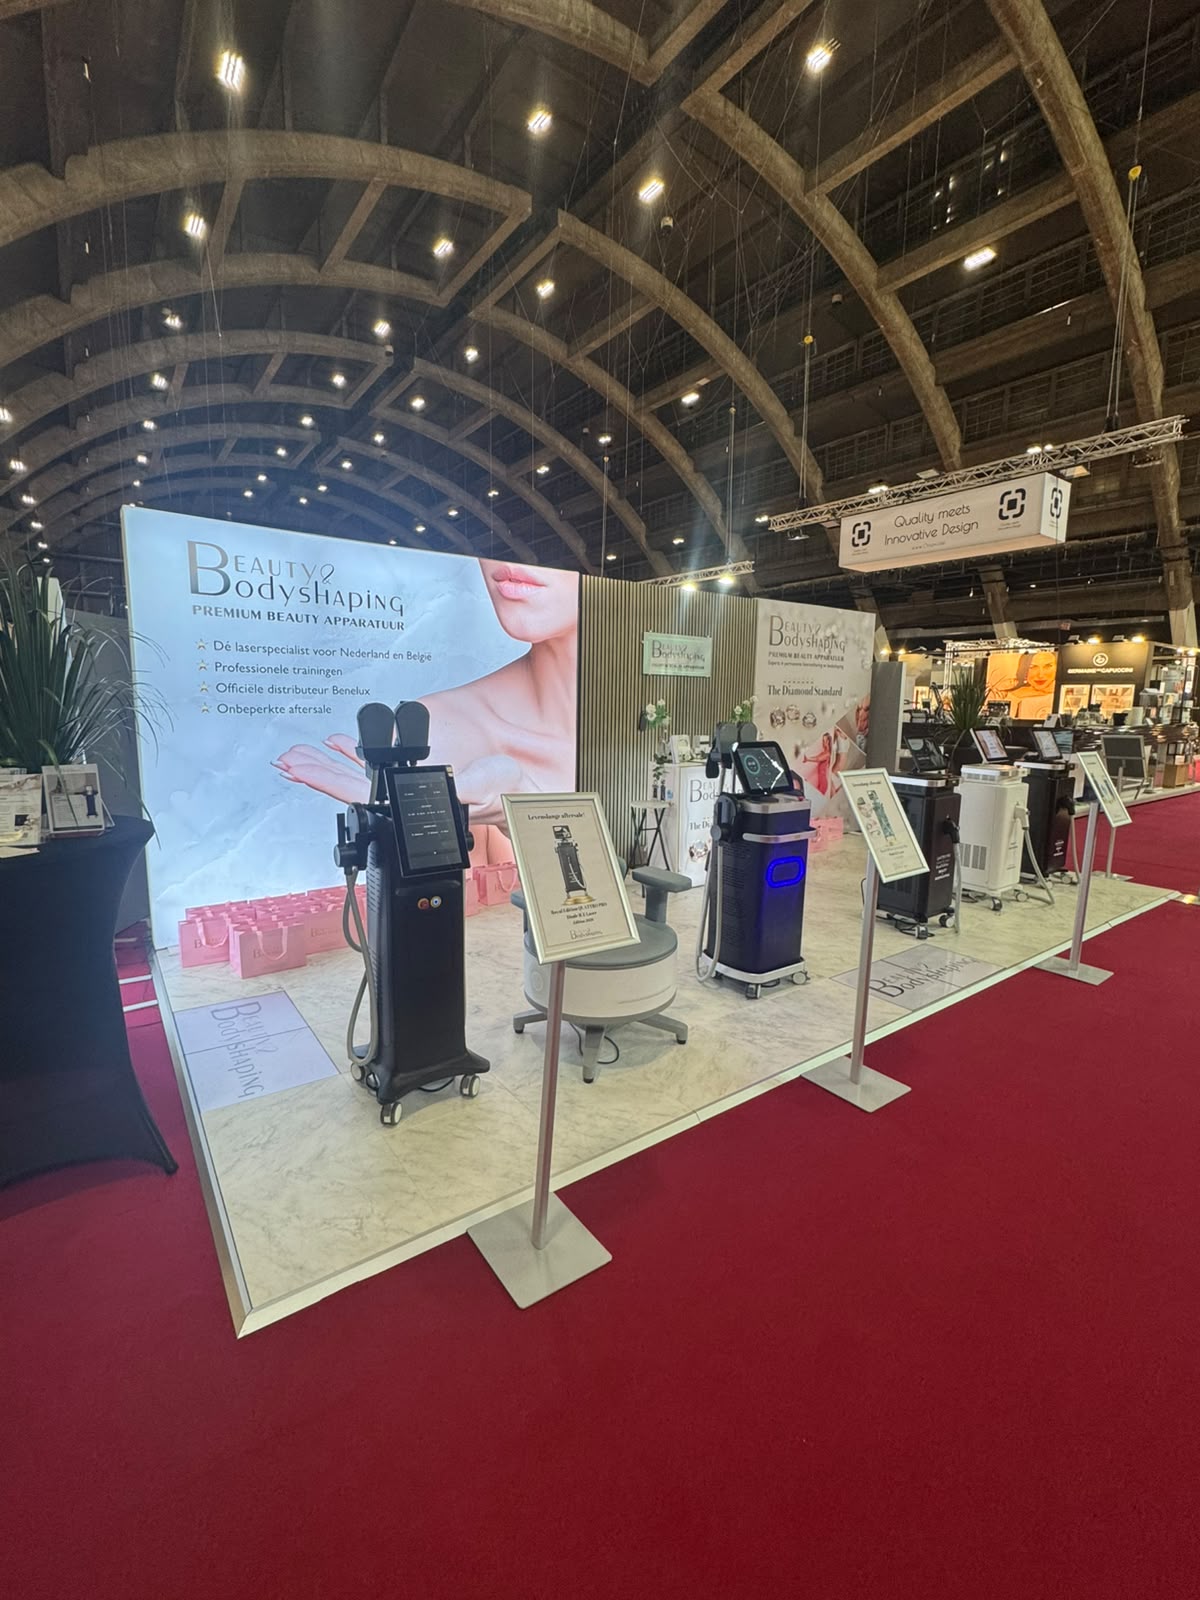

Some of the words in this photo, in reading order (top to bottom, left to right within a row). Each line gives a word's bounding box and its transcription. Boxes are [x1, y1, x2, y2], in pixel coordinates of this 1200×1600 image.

[894, 512, 934, 528] Quality
[938, 504, 971, 519] meets
[885, 527, 938, 546] Innovative
[942, 520, 979, 537] Design
[192, 605, 262, 620] PREMIUM
[267, 611, 319, 624] BEAUTY
[324, 616, 405, 631] APPARATUUR
[213, 640, 231, 652] Dé
[235, 642, 310, 656] laserspecialist
[313, 649, 337, 657] voor
[340, 647, 390, 659] Nederland
[393, 652, 404, 660] en
[214, 662, 289, 674] Professionele
[292, 665, 343, 678] trainingen
[216, 682, 264, 694] Officiële
[267, 684, 329, 695] distributeur
[332, 685, 370, 695] Benelux
[768, 685, 781, 696] The
[782, 685, 813, 696] Diamond
[814, 686, 843, 697] Standard
[217, 703, 286, 716] Onbeperkte
[289, 704, 332, 714] aftersale
